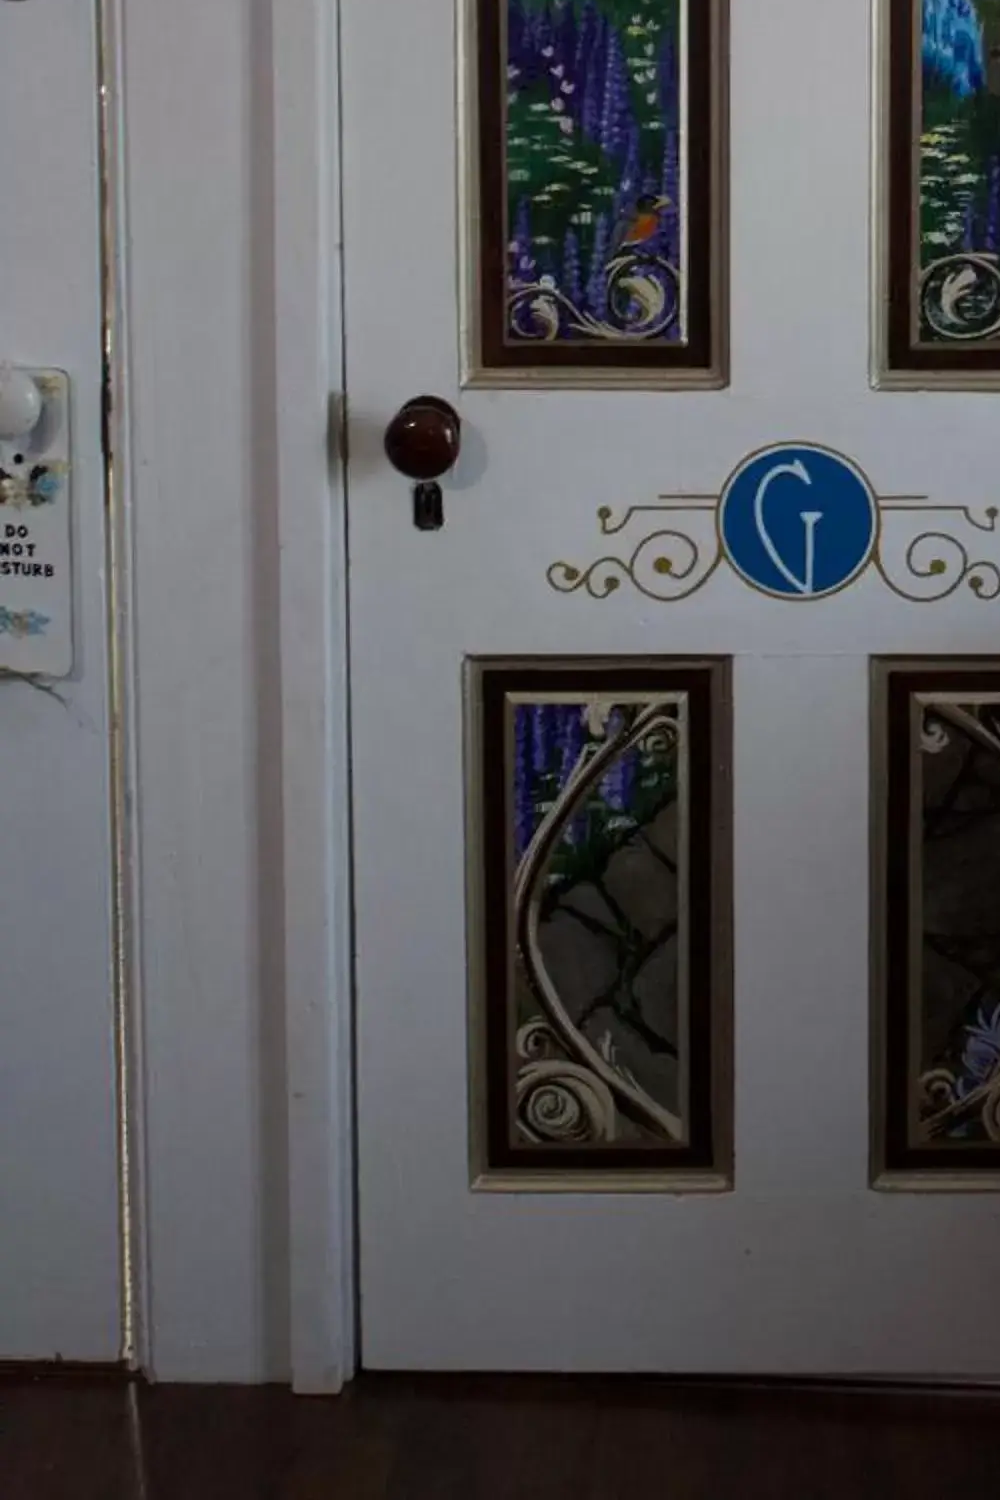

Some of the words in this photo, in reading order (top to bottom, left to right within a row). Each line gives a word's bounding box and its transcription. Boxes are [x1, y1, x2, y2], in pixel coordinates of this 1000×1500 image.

[5, 524, 28, 538] DO
[754, 459, 822, 594] G
[0, 543, 36, 557] NOT
